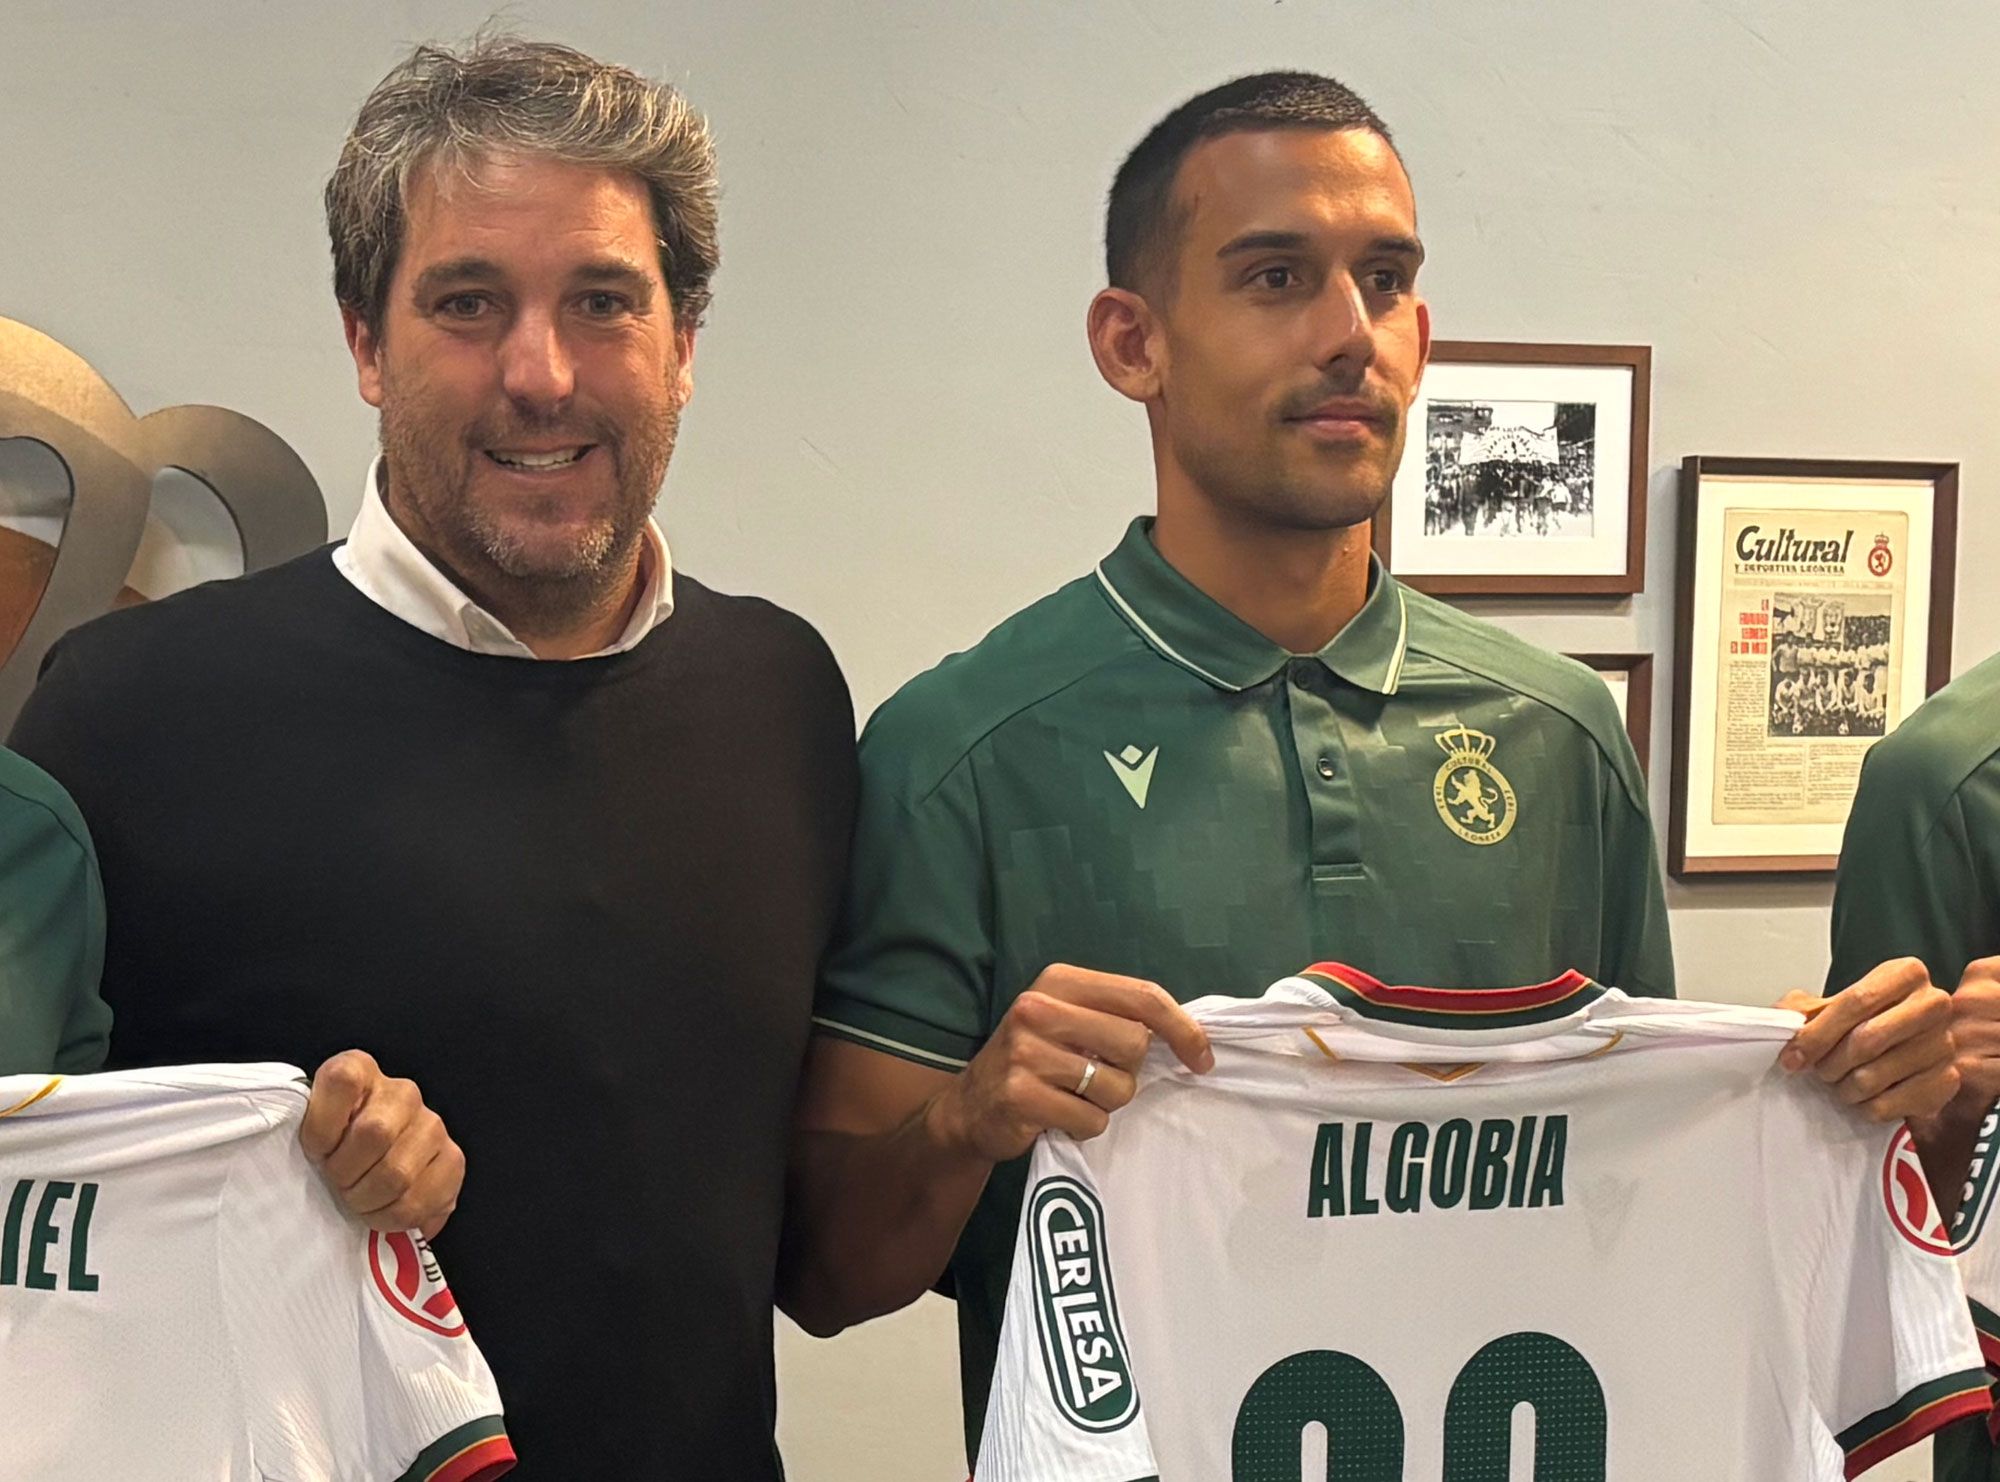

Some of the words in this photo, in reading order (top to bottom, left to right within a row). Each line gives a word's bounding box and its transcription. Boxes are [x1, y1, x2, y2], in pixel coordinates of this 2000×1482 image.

[1736, 525, 1854, 563] Cultural
[1307, 1115, 1568, 1218] ALGOBIA
[0, 1179, 99, 1292] IEL
[1039, 1197, 1122, 1409] CERLESA
